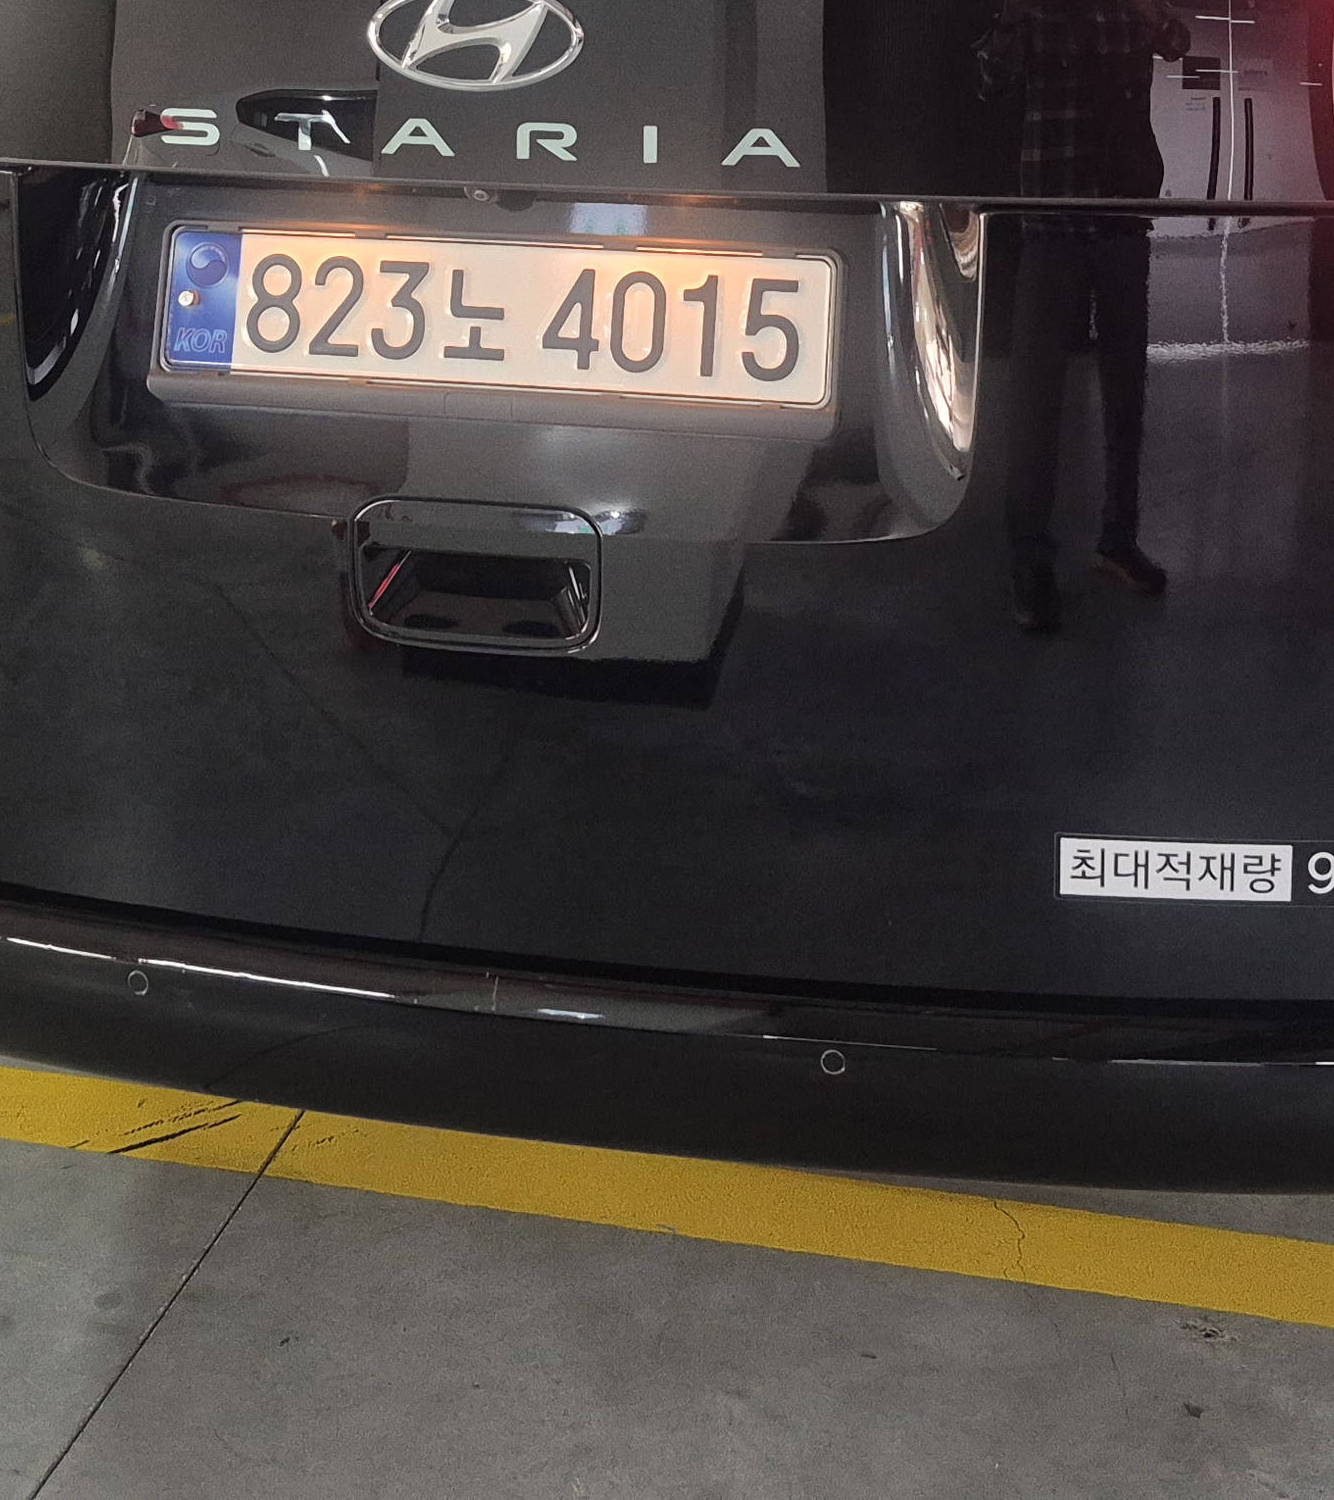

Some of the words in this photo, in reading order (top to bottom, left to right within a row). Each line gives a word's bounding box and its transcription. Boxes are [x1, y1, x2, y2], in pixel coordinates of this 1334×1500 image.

[160, 107, 801, 168] STARIA
[174, 327, 228, 354] KOR
[246, 253, 505, 363] 823노
[542, 268, 800, 382] 4015
[1070, 847, 1282, 894] 최대적재량
